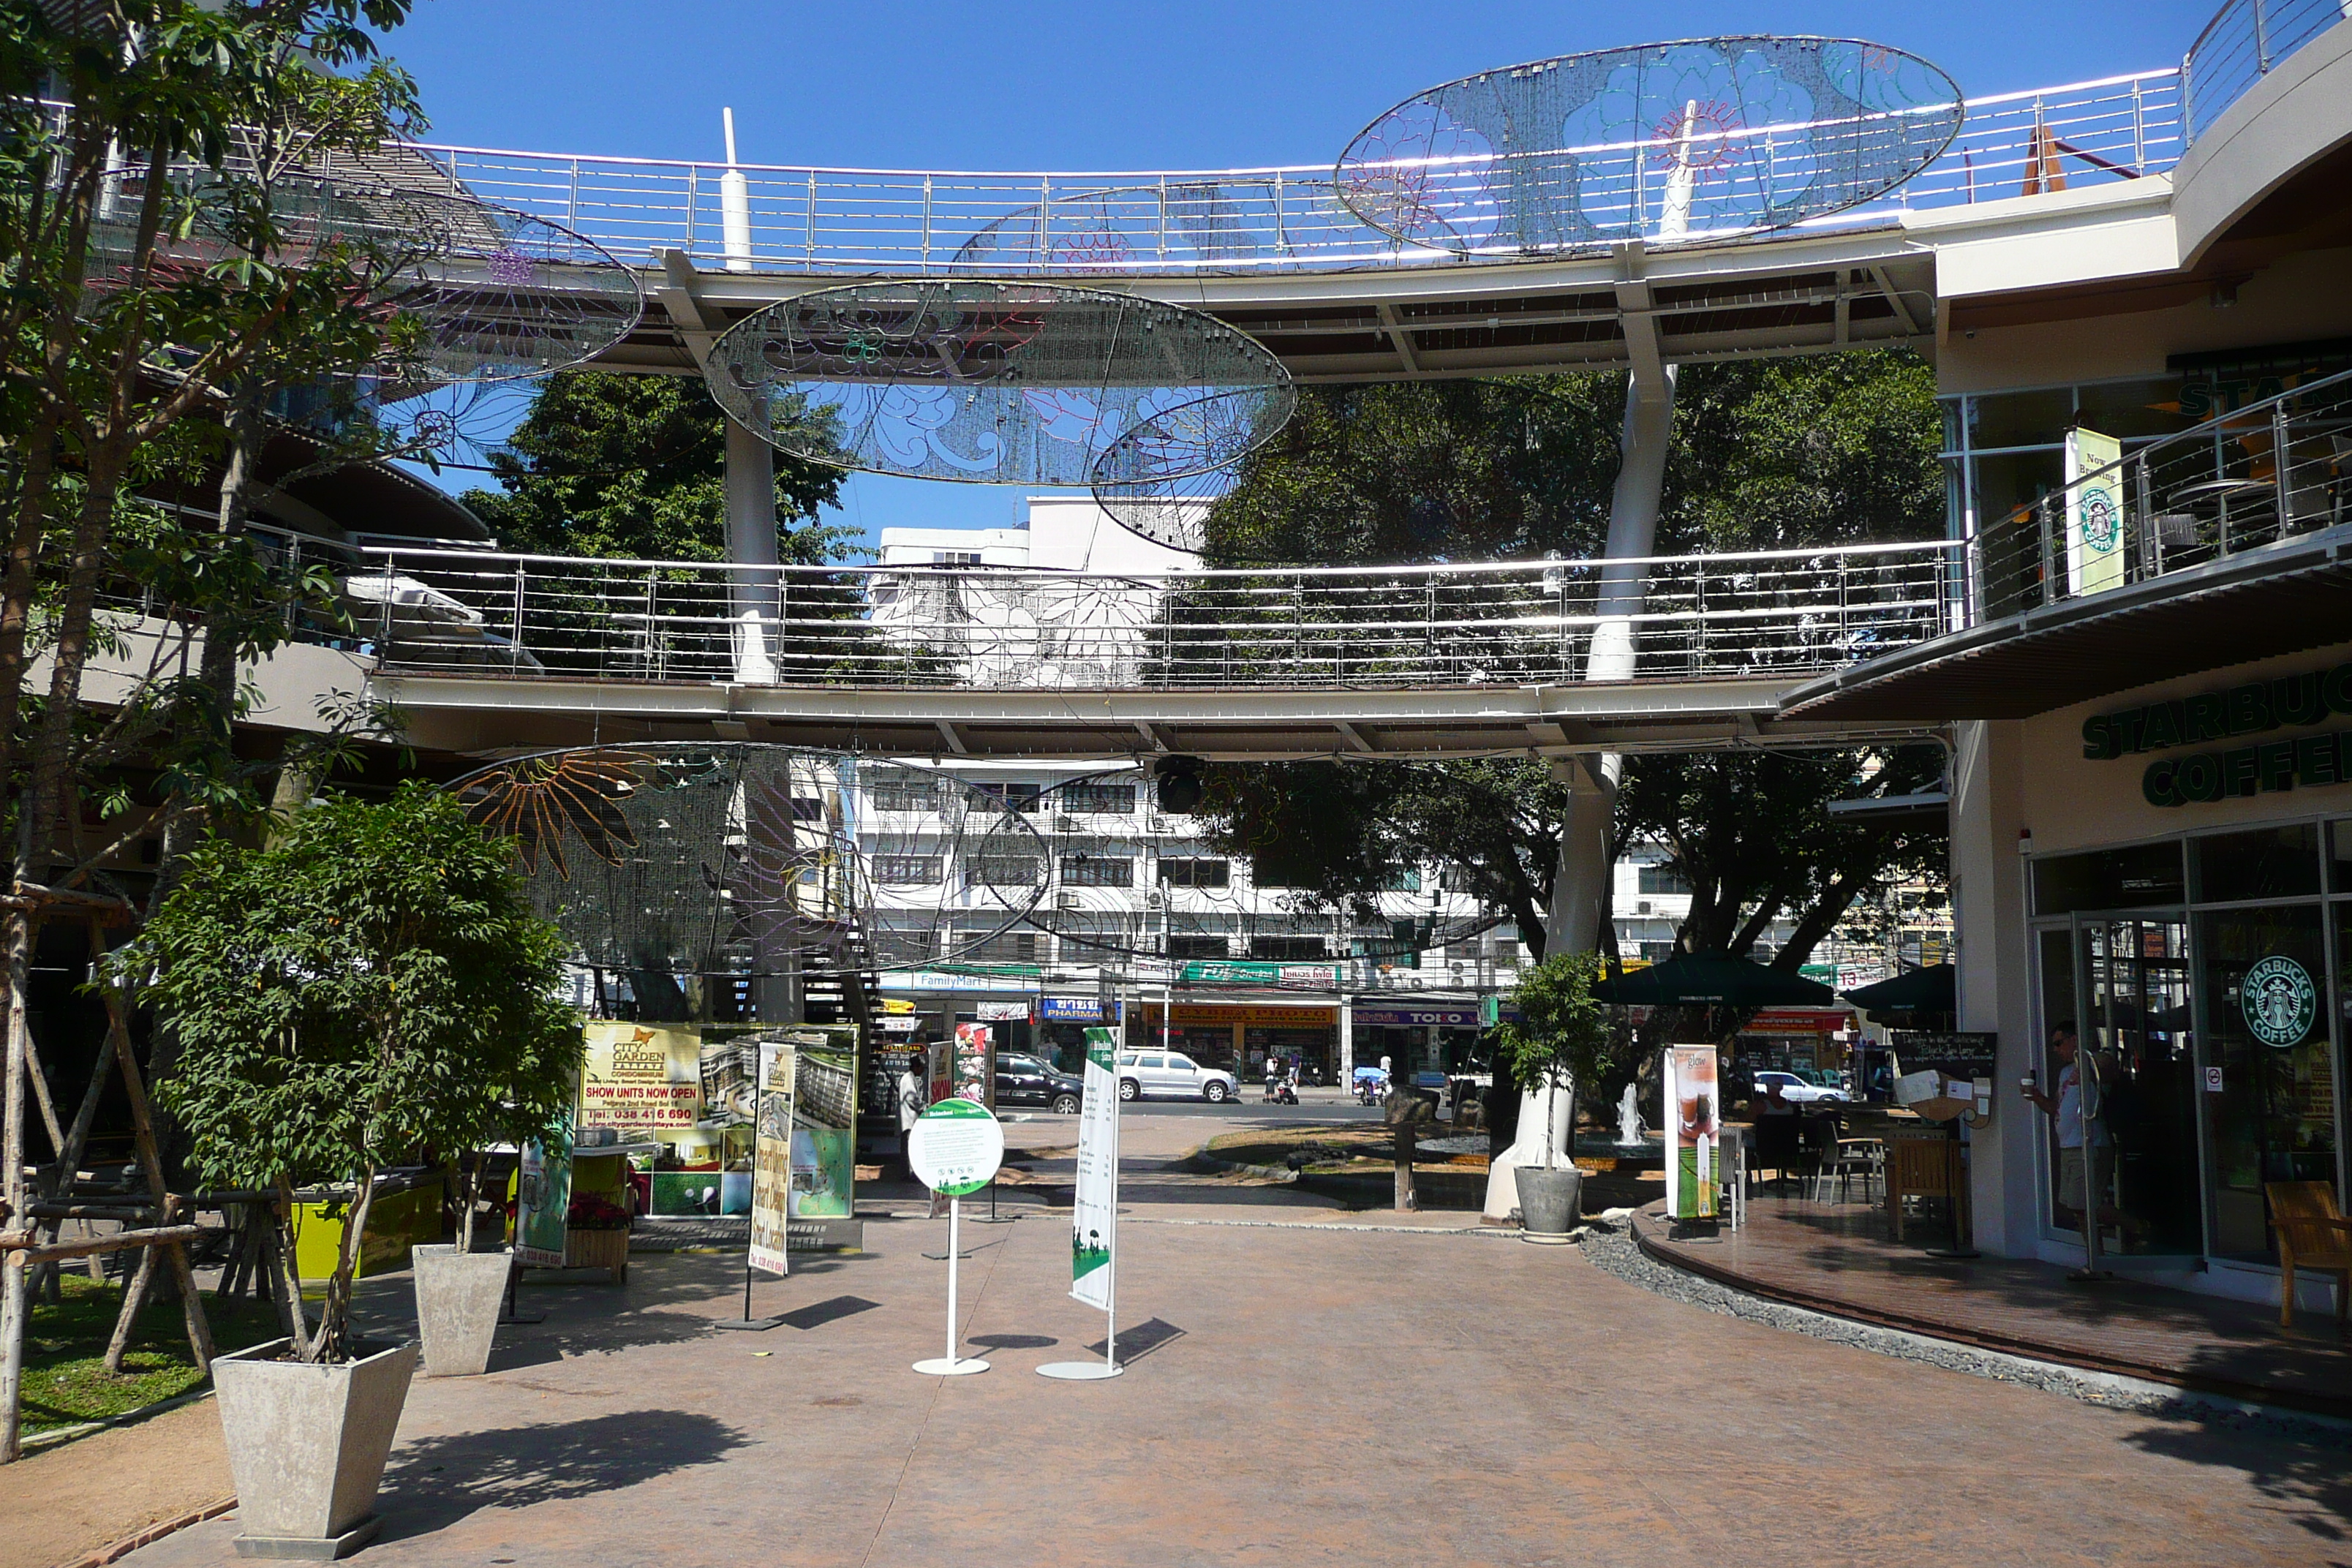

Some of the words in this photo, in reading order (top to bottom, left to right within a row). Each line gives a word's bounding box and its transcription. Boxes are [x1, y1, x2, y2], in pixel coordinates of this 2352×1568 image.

[2178, 371, 2352, 416] STAR
[2087, 453, 2106, 466] Now
[2079, 464, 2117, 484] Breing
[2081, 491, 2117, 521] STARBUCKS
[2085, 531, 2112, 550] COFFEE
[921, 975, 981, 989] FamilyMart
[1840, 972, 1856, 986] 13
[2245, 960, 2312, 999] STARBUCKS
[1179, 1009, 1248, 1017] CYBER
[1410, 1013, 1462, 1023] TOKO
[2253, 1019, 2304, 1043] COFFEE
[613, 1043, 643, 1052] CITY
[613, 1052, 665, 1061] GARDEN
[1688, 1054, 1705, 1069] glow
[586, 1088, 614, 1098] SHOW
[617, 1088, 644, 1098] UNITS
[647, 1088, 668, 1098] NOW
[671, 1088, 696, 1098] OPEN
[614, 1109, 638, 1119] 038
[668, 1109, 691, 1119] 690
[757, 1142, 772, 1172] Smart
[772, 1145, 788, 1183] Living
[755, 1177, 769, 1209] Smart
[770, 1182, 785, 1221] Design
[753, 1215, 766, 1248] Smart
